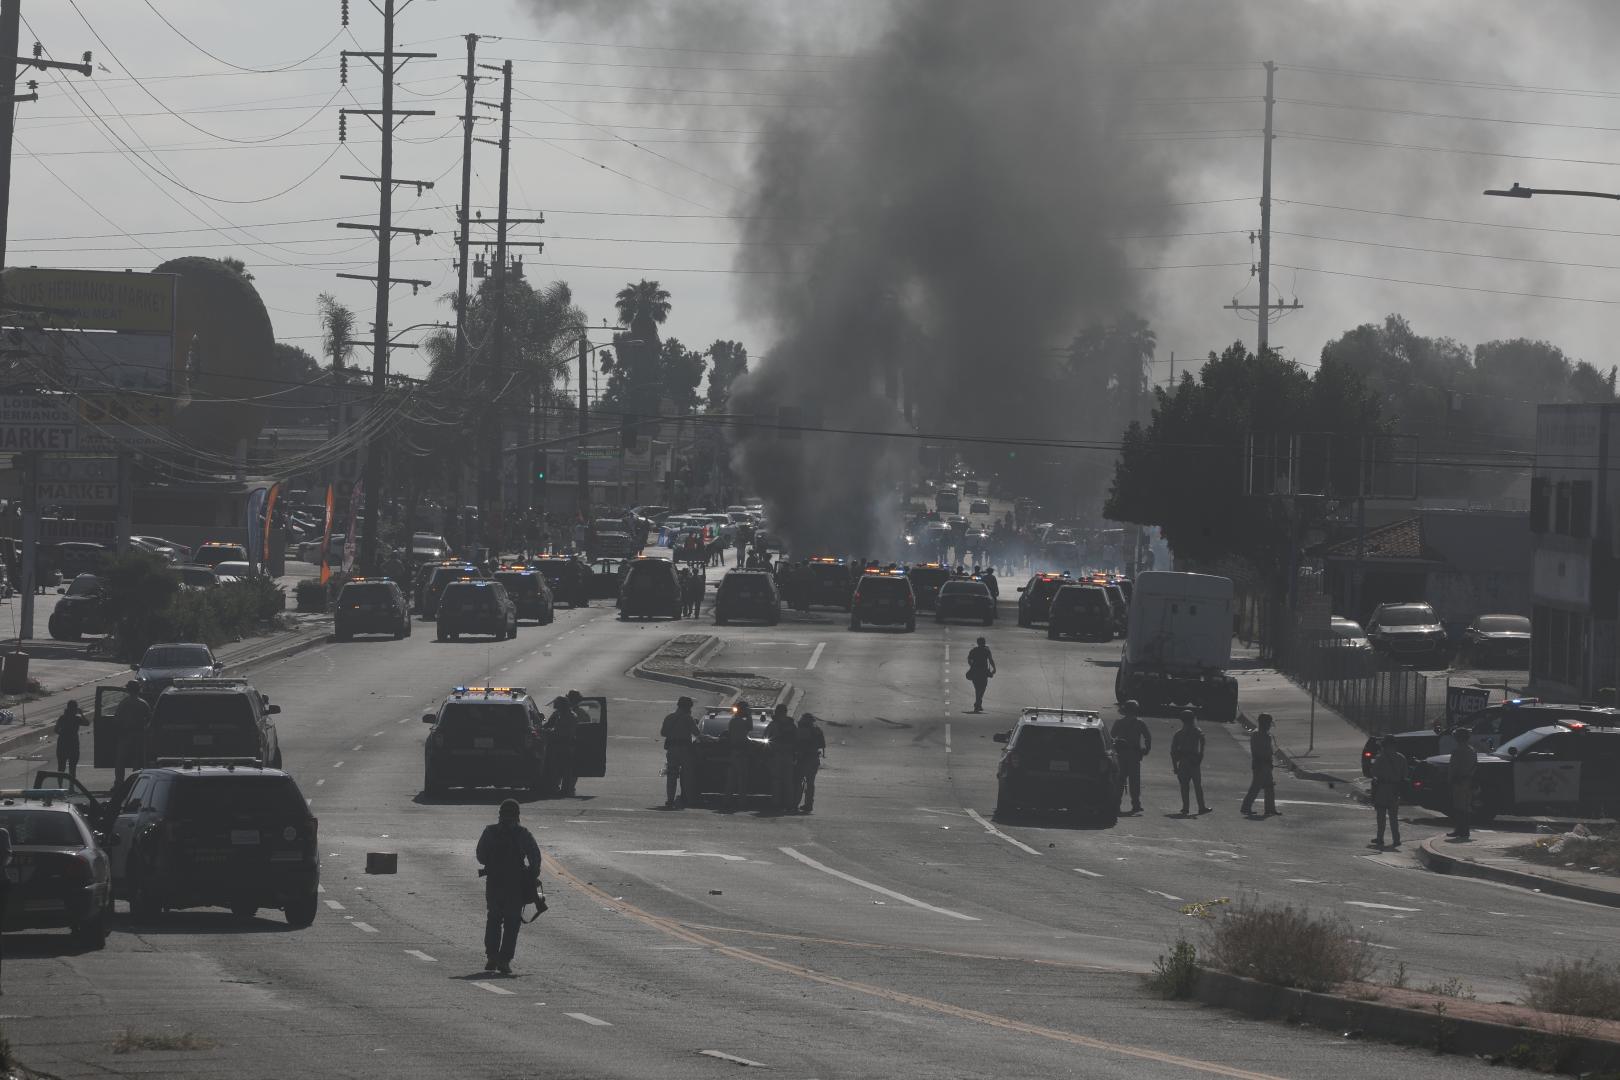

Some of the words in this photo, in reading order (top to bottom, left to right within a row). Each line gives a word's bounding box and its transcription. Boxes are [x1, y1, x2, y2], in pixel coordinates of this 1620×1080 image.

[48, 279, 115, 305] HERMANOS
[119, 283, 167, 314] MARKET
[38, 484, 117, 499] MARKET
